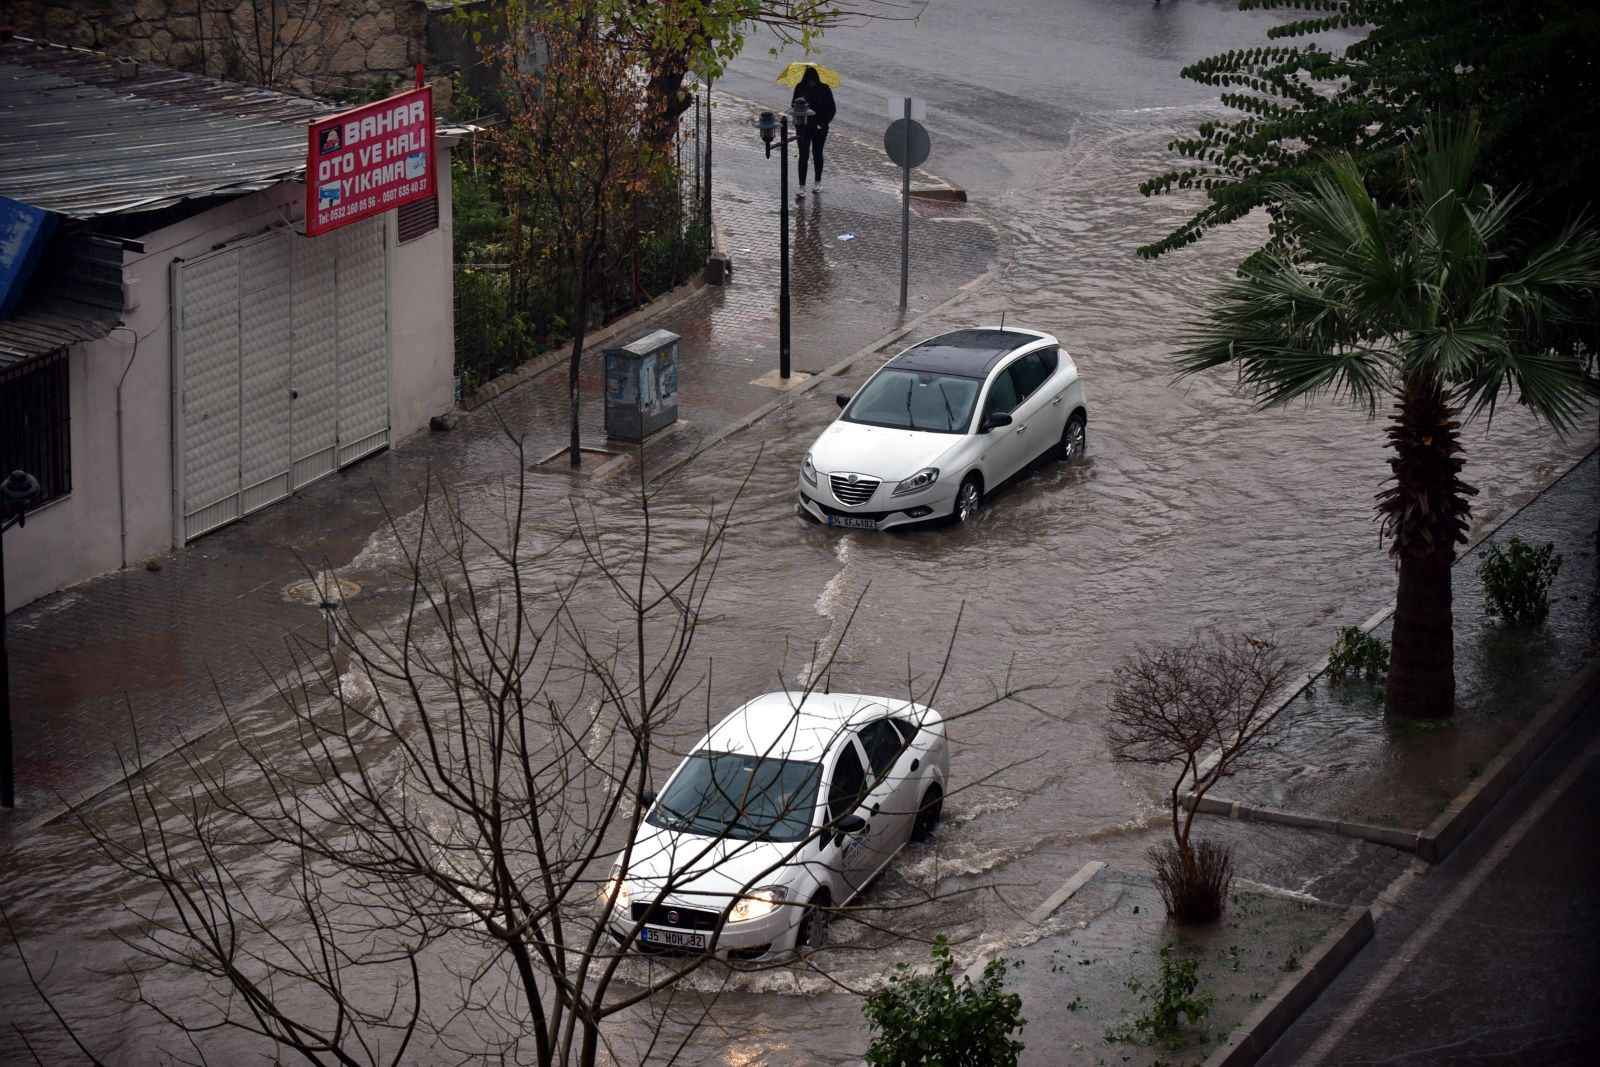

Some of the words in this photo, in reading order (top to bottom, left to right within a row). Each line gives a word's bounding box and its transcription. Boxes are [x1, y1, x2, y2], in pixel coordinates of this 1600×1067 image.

[344, 100, 425, 146] BAHAR
[318, 153, 355, 181] OTO
[359, 142, 382, 167] VE
[386, 128, 426, 159] HALI
[318, 212, 329, 225] Tel:
[330, 206, 346, 221] 0532
[359, 199, 367, 211] 05
[367, 197, 376, 209] 56
[382, 188, 397, 203] 0507
[398, 184, 410, 198] 635
[410, 181, 419, 193] 40
[419, 178, 427, 190] 37
[342, 160, 406, 197] YIKAMA
[648, 930, 659, 941] 35
[665, 934, 683, 945] HOH
[690, 936, 702, 947] 32
